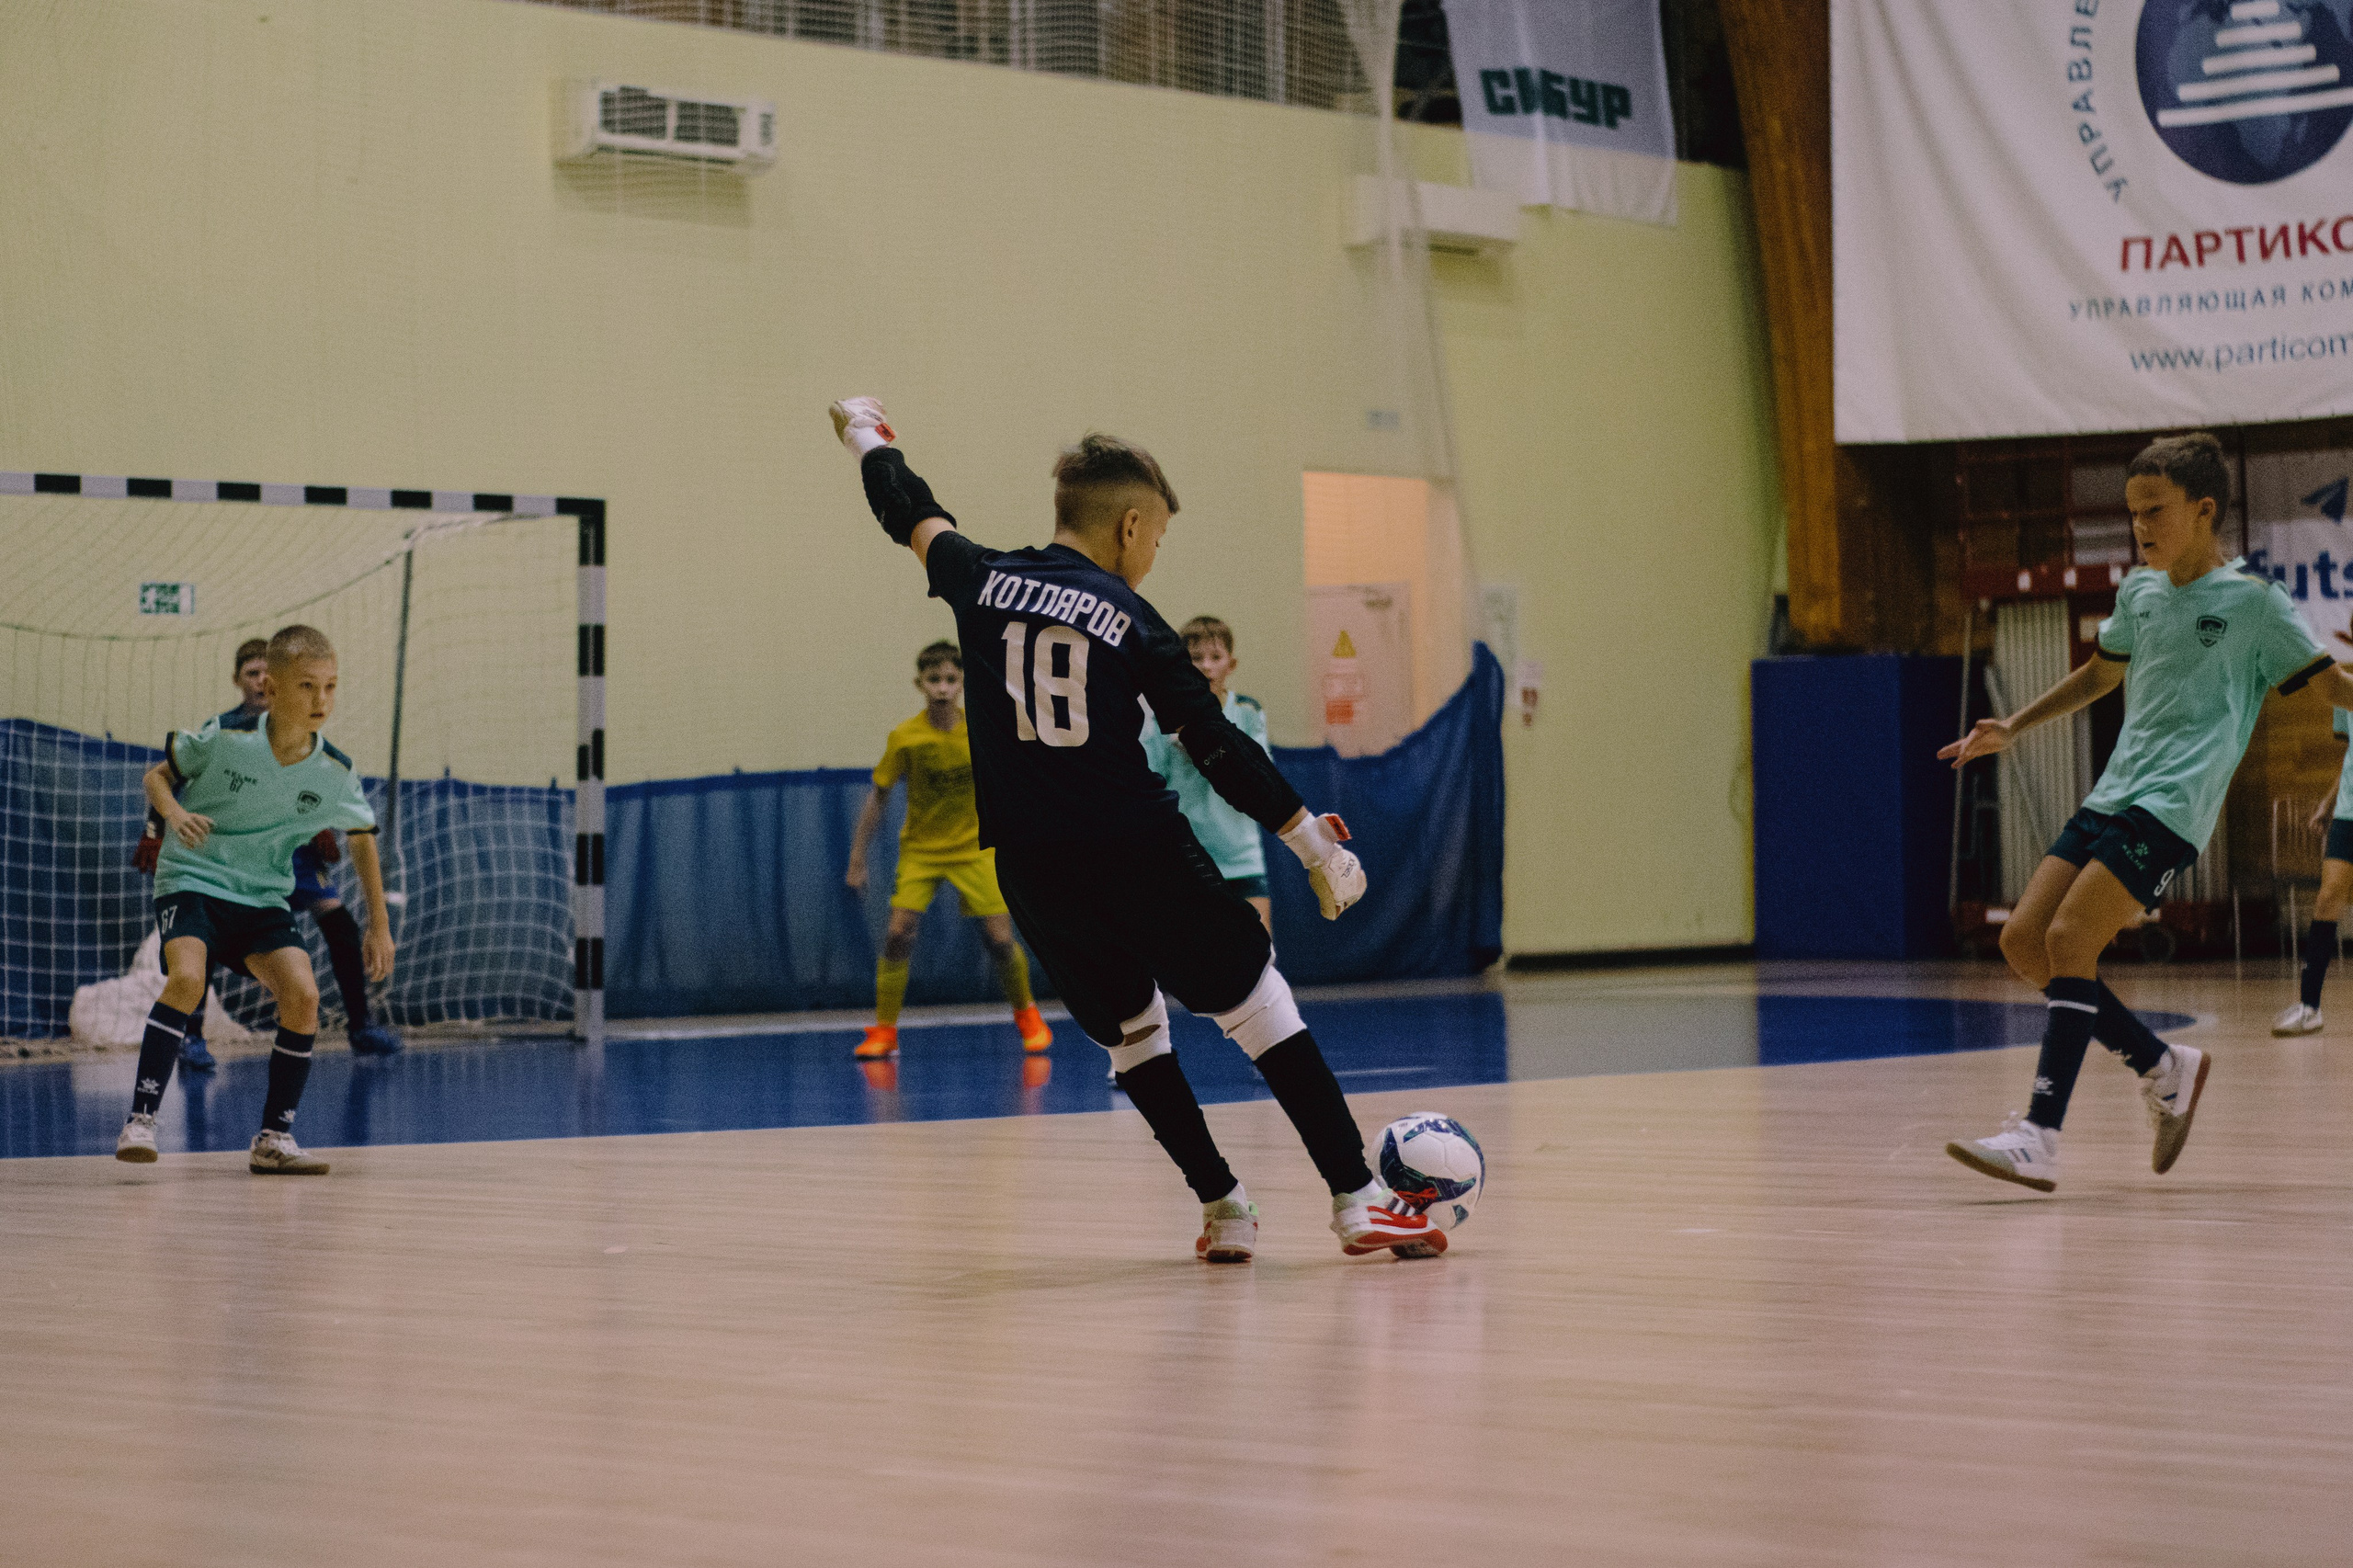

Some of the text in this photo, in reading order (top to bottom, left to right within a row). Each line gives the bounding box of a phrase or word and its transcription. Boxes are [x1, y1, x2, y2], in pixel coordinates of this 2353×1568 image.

[2069, 284, 2287, 320] УПРАВЛЯЮЩАЯ
[977, 570, 1131, 647] КОТЛЯРОВ
[1001, 621, 1090, 747] 18
[2154, 868, 2176, 897] 9
[161, 904, 178, 935] 67
